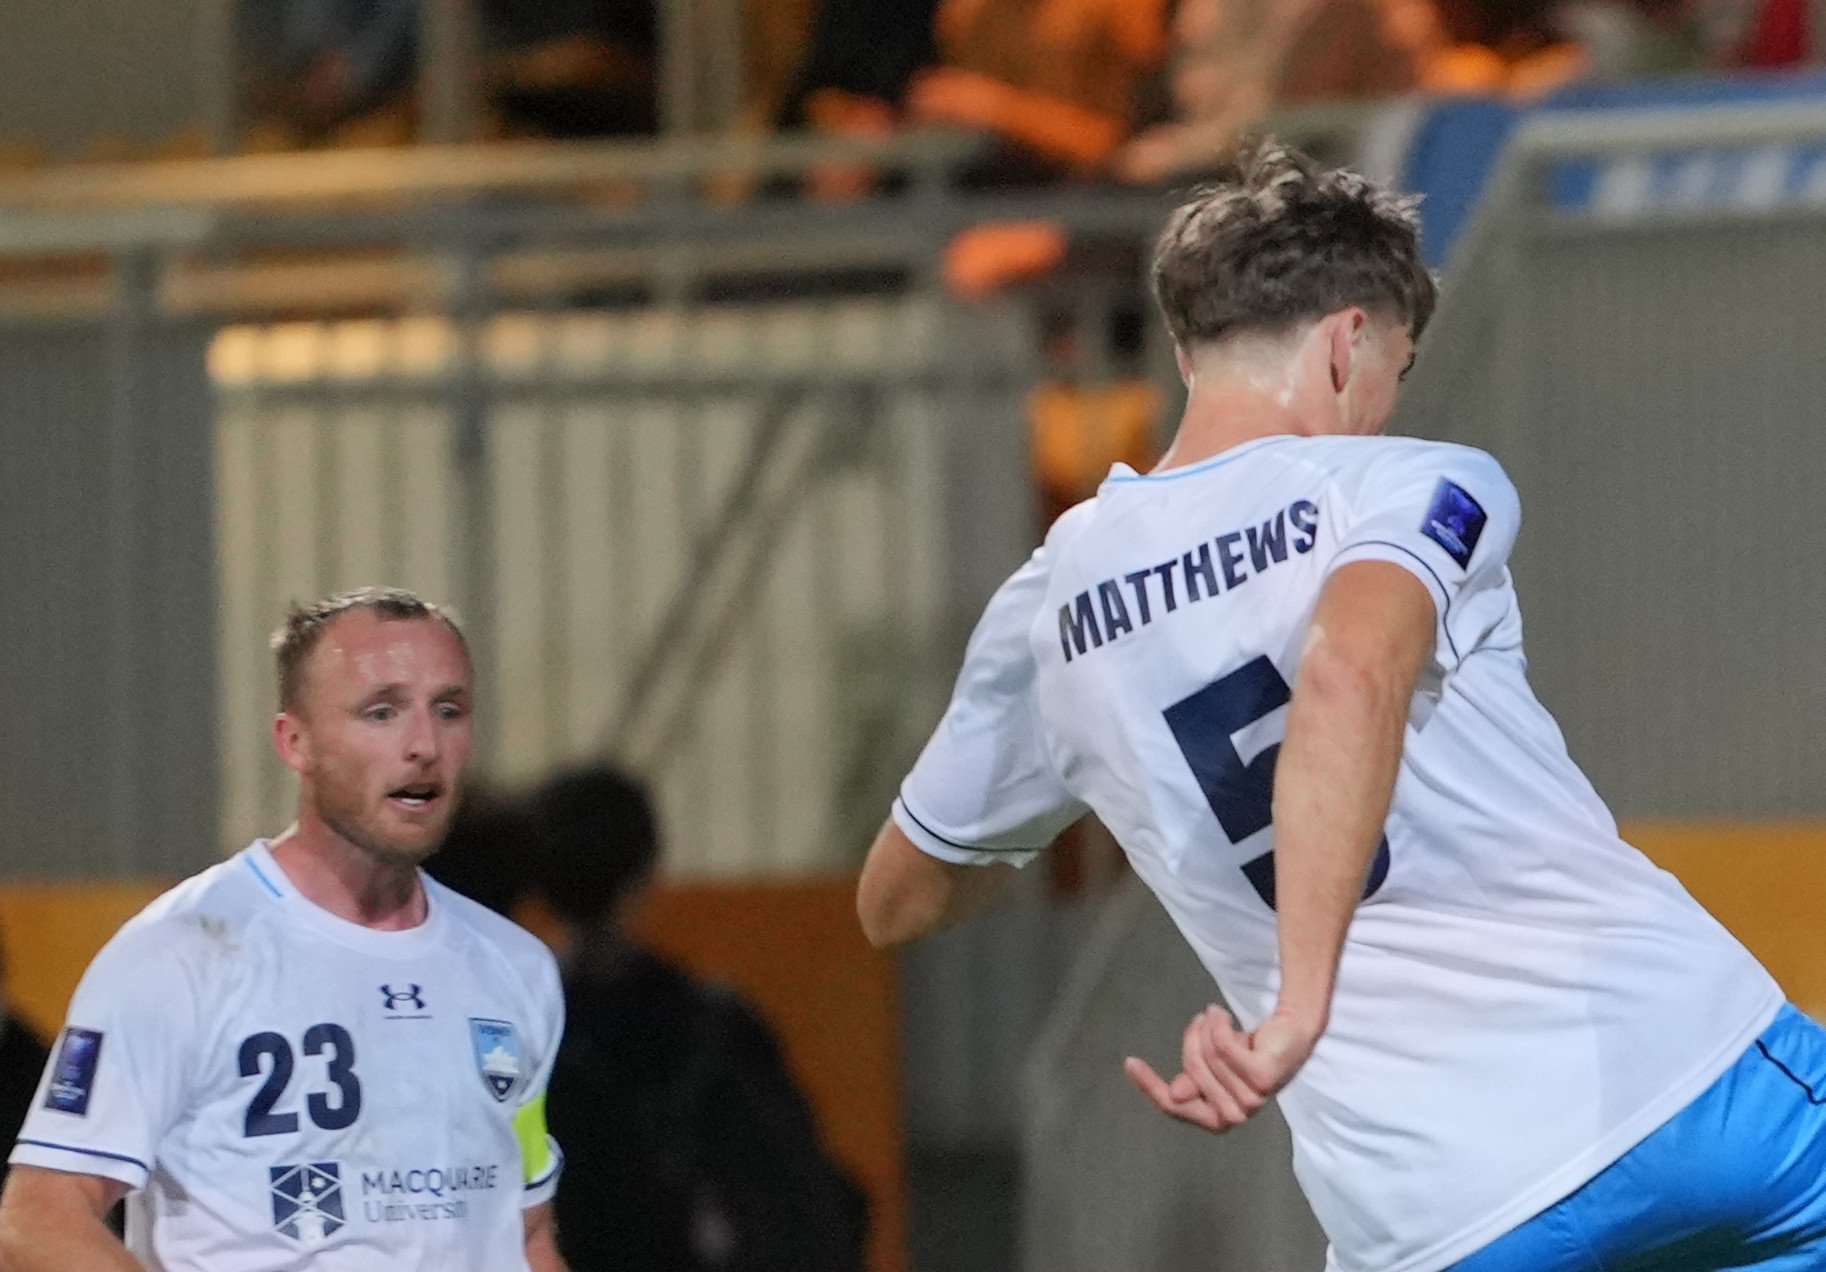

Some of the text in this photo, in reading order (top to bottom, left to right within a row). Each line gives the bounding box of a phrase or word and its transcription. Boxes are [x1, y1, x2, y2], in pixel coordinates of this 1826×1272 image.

[1058, 499, 1319, 663] MATTHEWS
[1163, 653, 1391, 913] 5
[238, 1022, 362, 1138] 23
